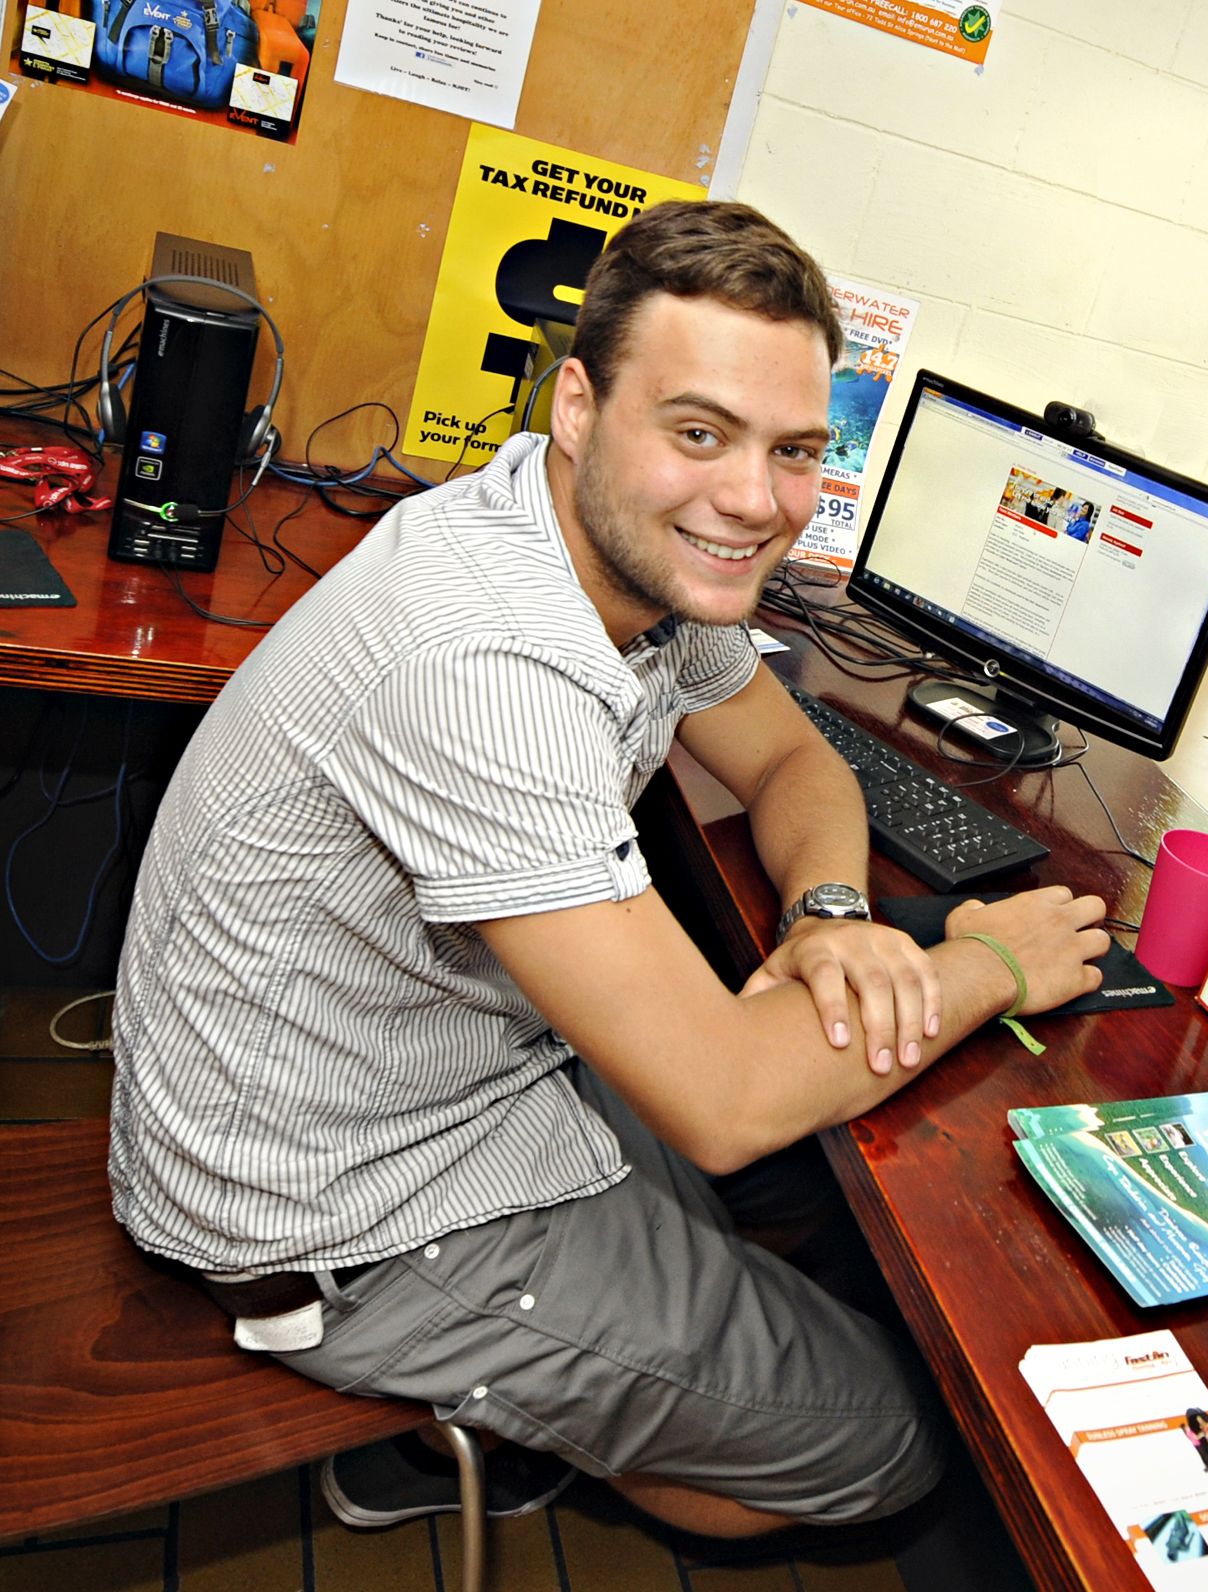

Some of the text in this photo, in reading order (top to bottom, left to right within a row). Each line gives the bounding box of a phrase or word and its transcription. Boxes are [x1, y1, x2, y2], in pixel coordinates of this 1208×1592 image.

[531, 159, 648, 204] GET YOUR
[479, 165, 630, 219] TAX REFUND
[832, 287, 910, 319] ERWATER
[850, 308, 903, 336] HIRE
[156, 318, 171, 358] emachines
[850, 329, 869, 341] FREE
[423, 410, 487, 436] Pick up
[419, 429, 461, 446] your
[820, 466, 851, 480] AMERAS
[834, 484, 857, 496] DAYS
[816, 494, 856, 522] $95
[811, 524, 828, 534] USE
[831, 519, 853, 529] TOTAL
[805, 533, 829, 543] MODE
[797, 540, 846, 555] PLUS VIDEO
